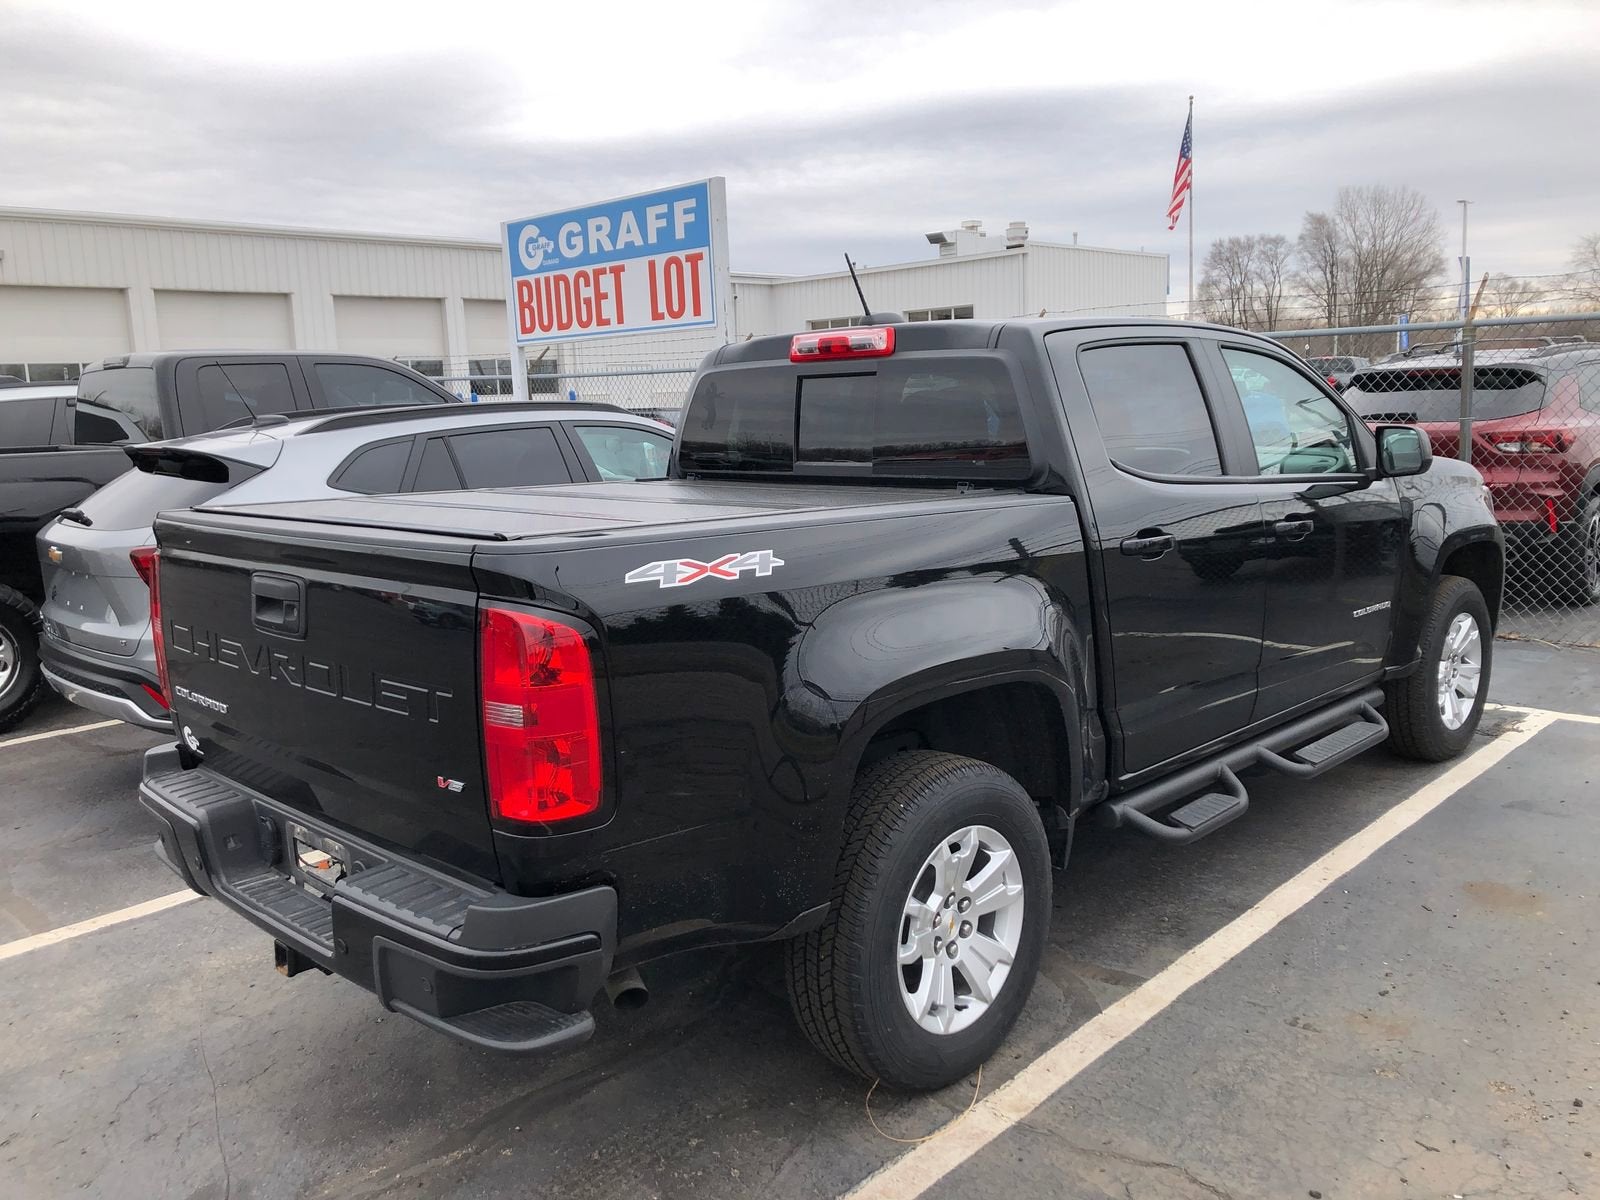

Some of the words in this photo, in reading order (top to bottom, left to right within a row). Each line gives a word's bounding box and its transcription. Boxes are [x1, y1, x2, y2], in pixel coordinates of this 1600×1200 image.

[558, 197, 697, 259] GRAFF
[516, 264, 626, 335] BUDGET
[647, 252, 704, 322] LOT
[625, 549, 785, 589] 4X4
[1353, 600, 1391, 618] COLORADO
[170, 619, 454, 724] CHEVROLET
[175, 685, 229, 714] COLORADO
[437, 775, 465, 793] V6
